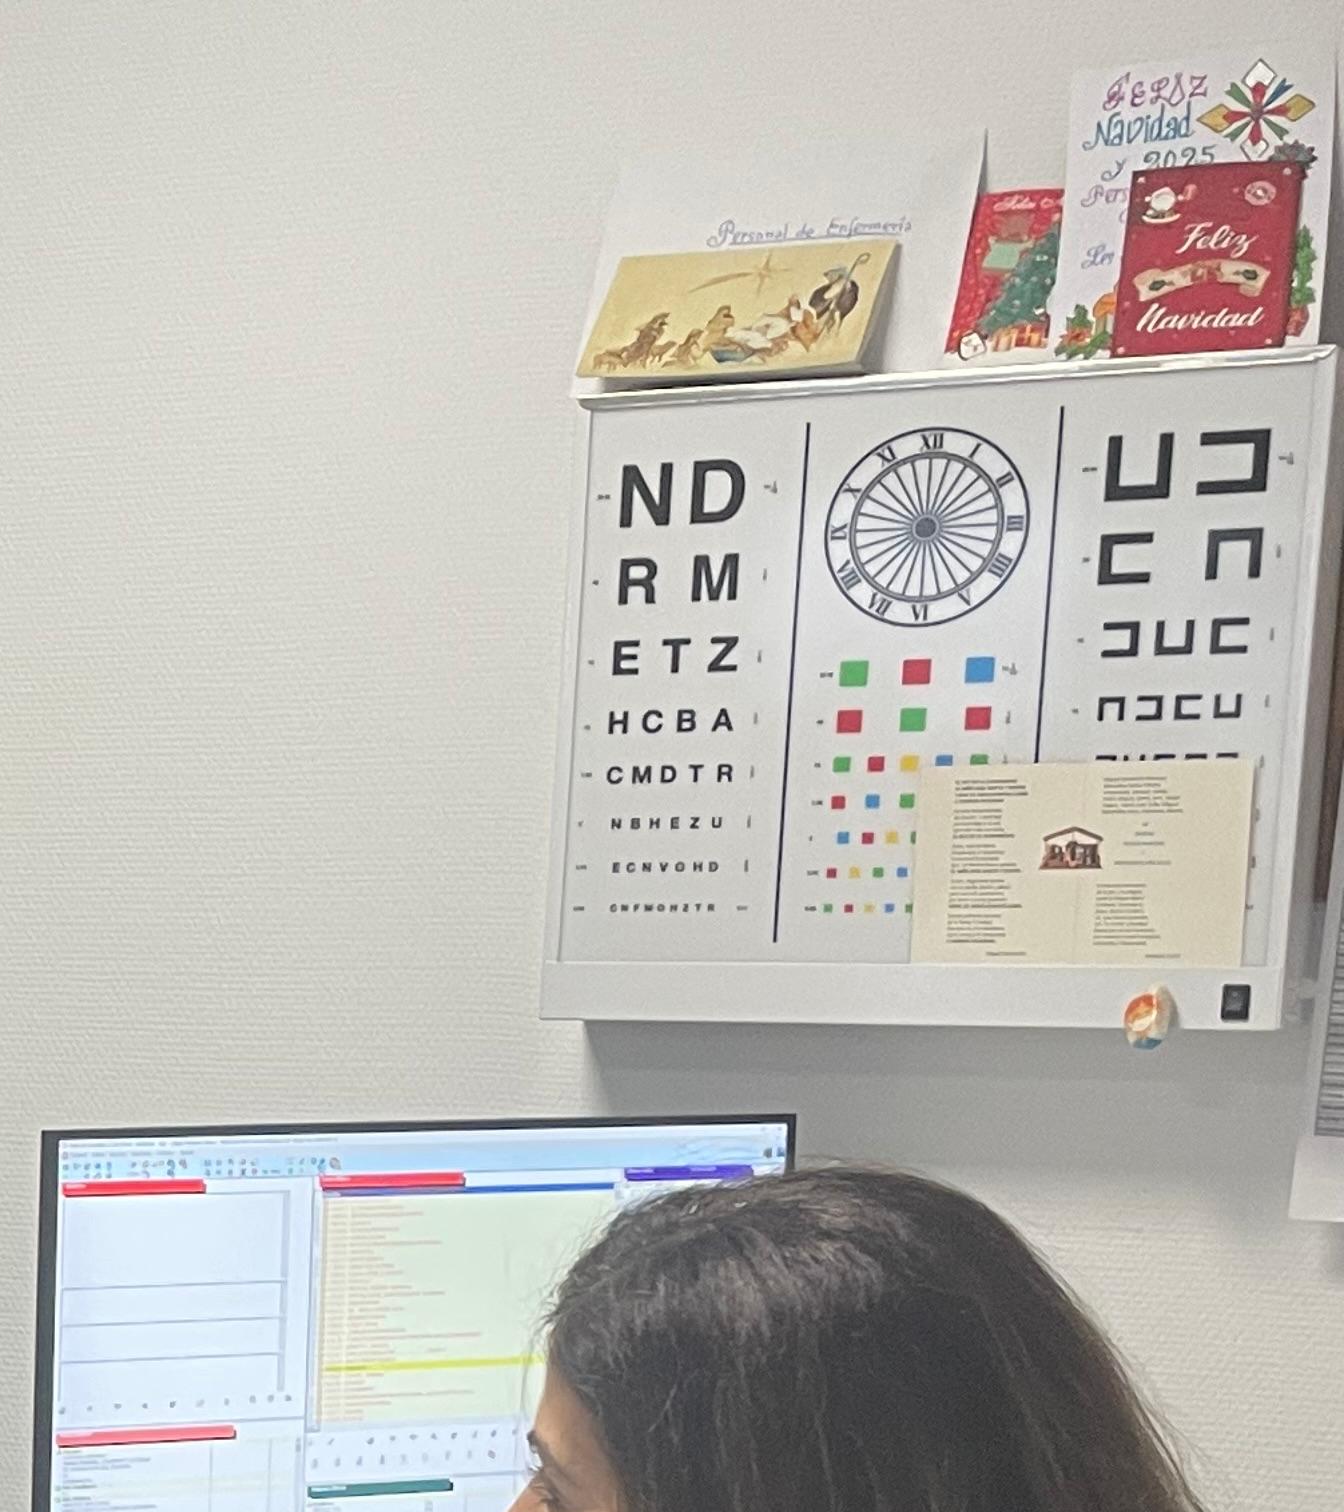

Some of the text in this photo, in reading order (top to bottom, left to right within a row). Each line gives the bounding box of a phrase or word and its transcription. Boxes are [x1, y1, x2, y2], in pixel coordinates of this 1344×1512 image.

[1082, 101, 1195, 151] Navidad
[706, 219, 789, 247] Personal
[795, 223, 814, 239] de
[1175, 222, 1260, 258] Feliz
[1135, 303, 1264, 333] Navidad
